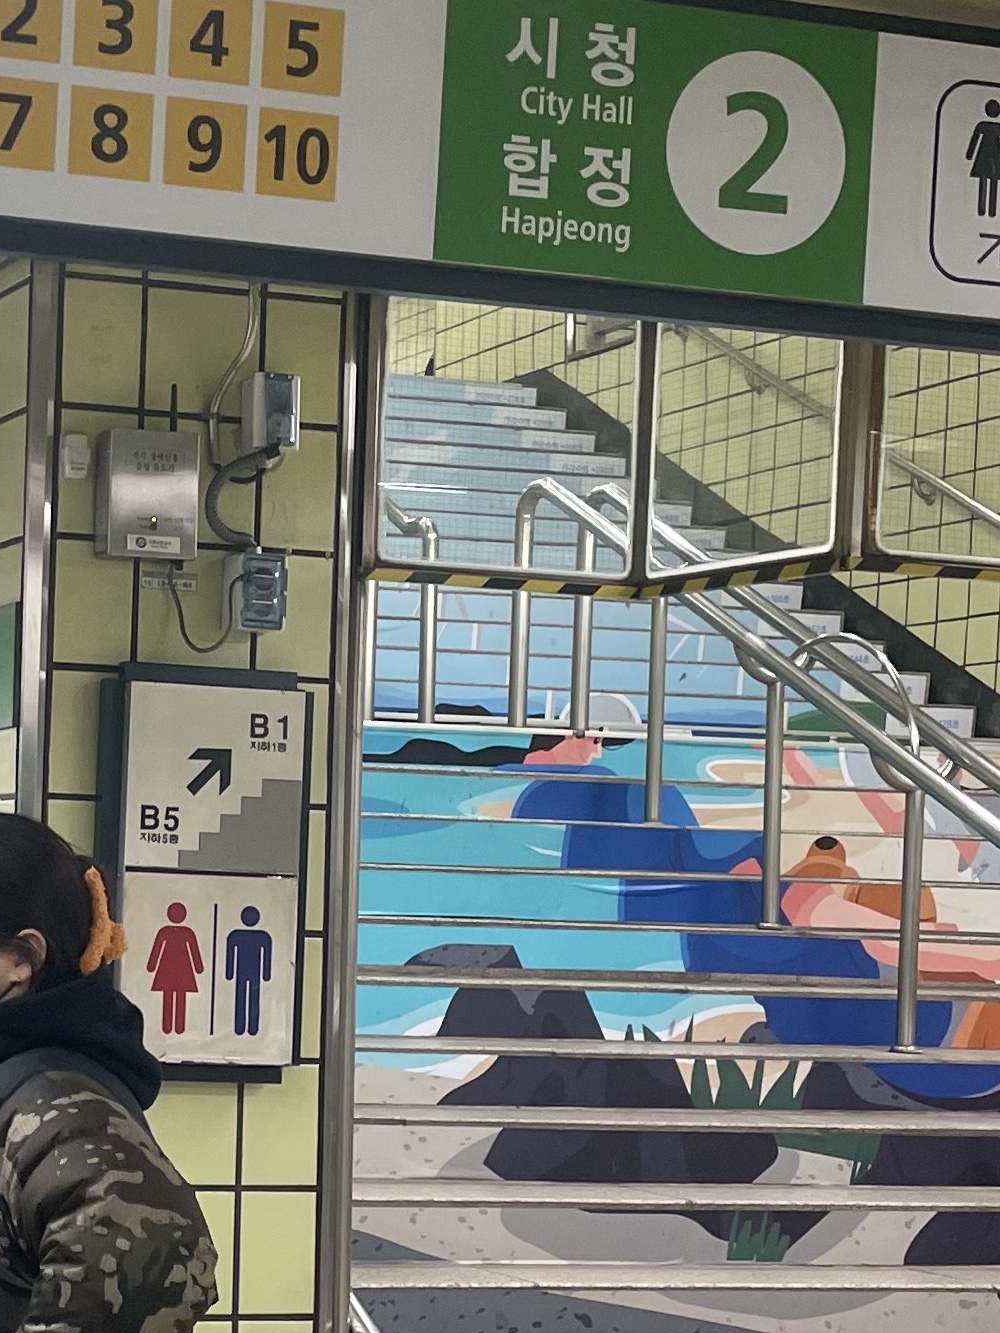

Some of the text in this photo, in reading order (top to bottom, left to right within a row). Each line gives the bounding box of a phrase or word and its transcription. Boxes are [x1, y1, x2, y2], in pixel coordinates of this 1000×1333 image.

[0, 0, 38, 46] 2
[97, 0, 135, 56] 3
[189, 10, 229, 67] 4
[285, 20, 321, 78] 5
[520, 86, 633, 126] City Hall
[90, 104, 129, 163] 8
[186, 115, 223, 174] 9
[264, 124, 330, 186] 10
[717, 91, 790, 215] 2
[500, 206, 632, 253] Hapjeong
[250, 713, 289, 741] B1
[250, 741, 287, 753] 지하1층
[139, 804, 180, 832] B5
[139, 832, 179, 845] 지하5층
